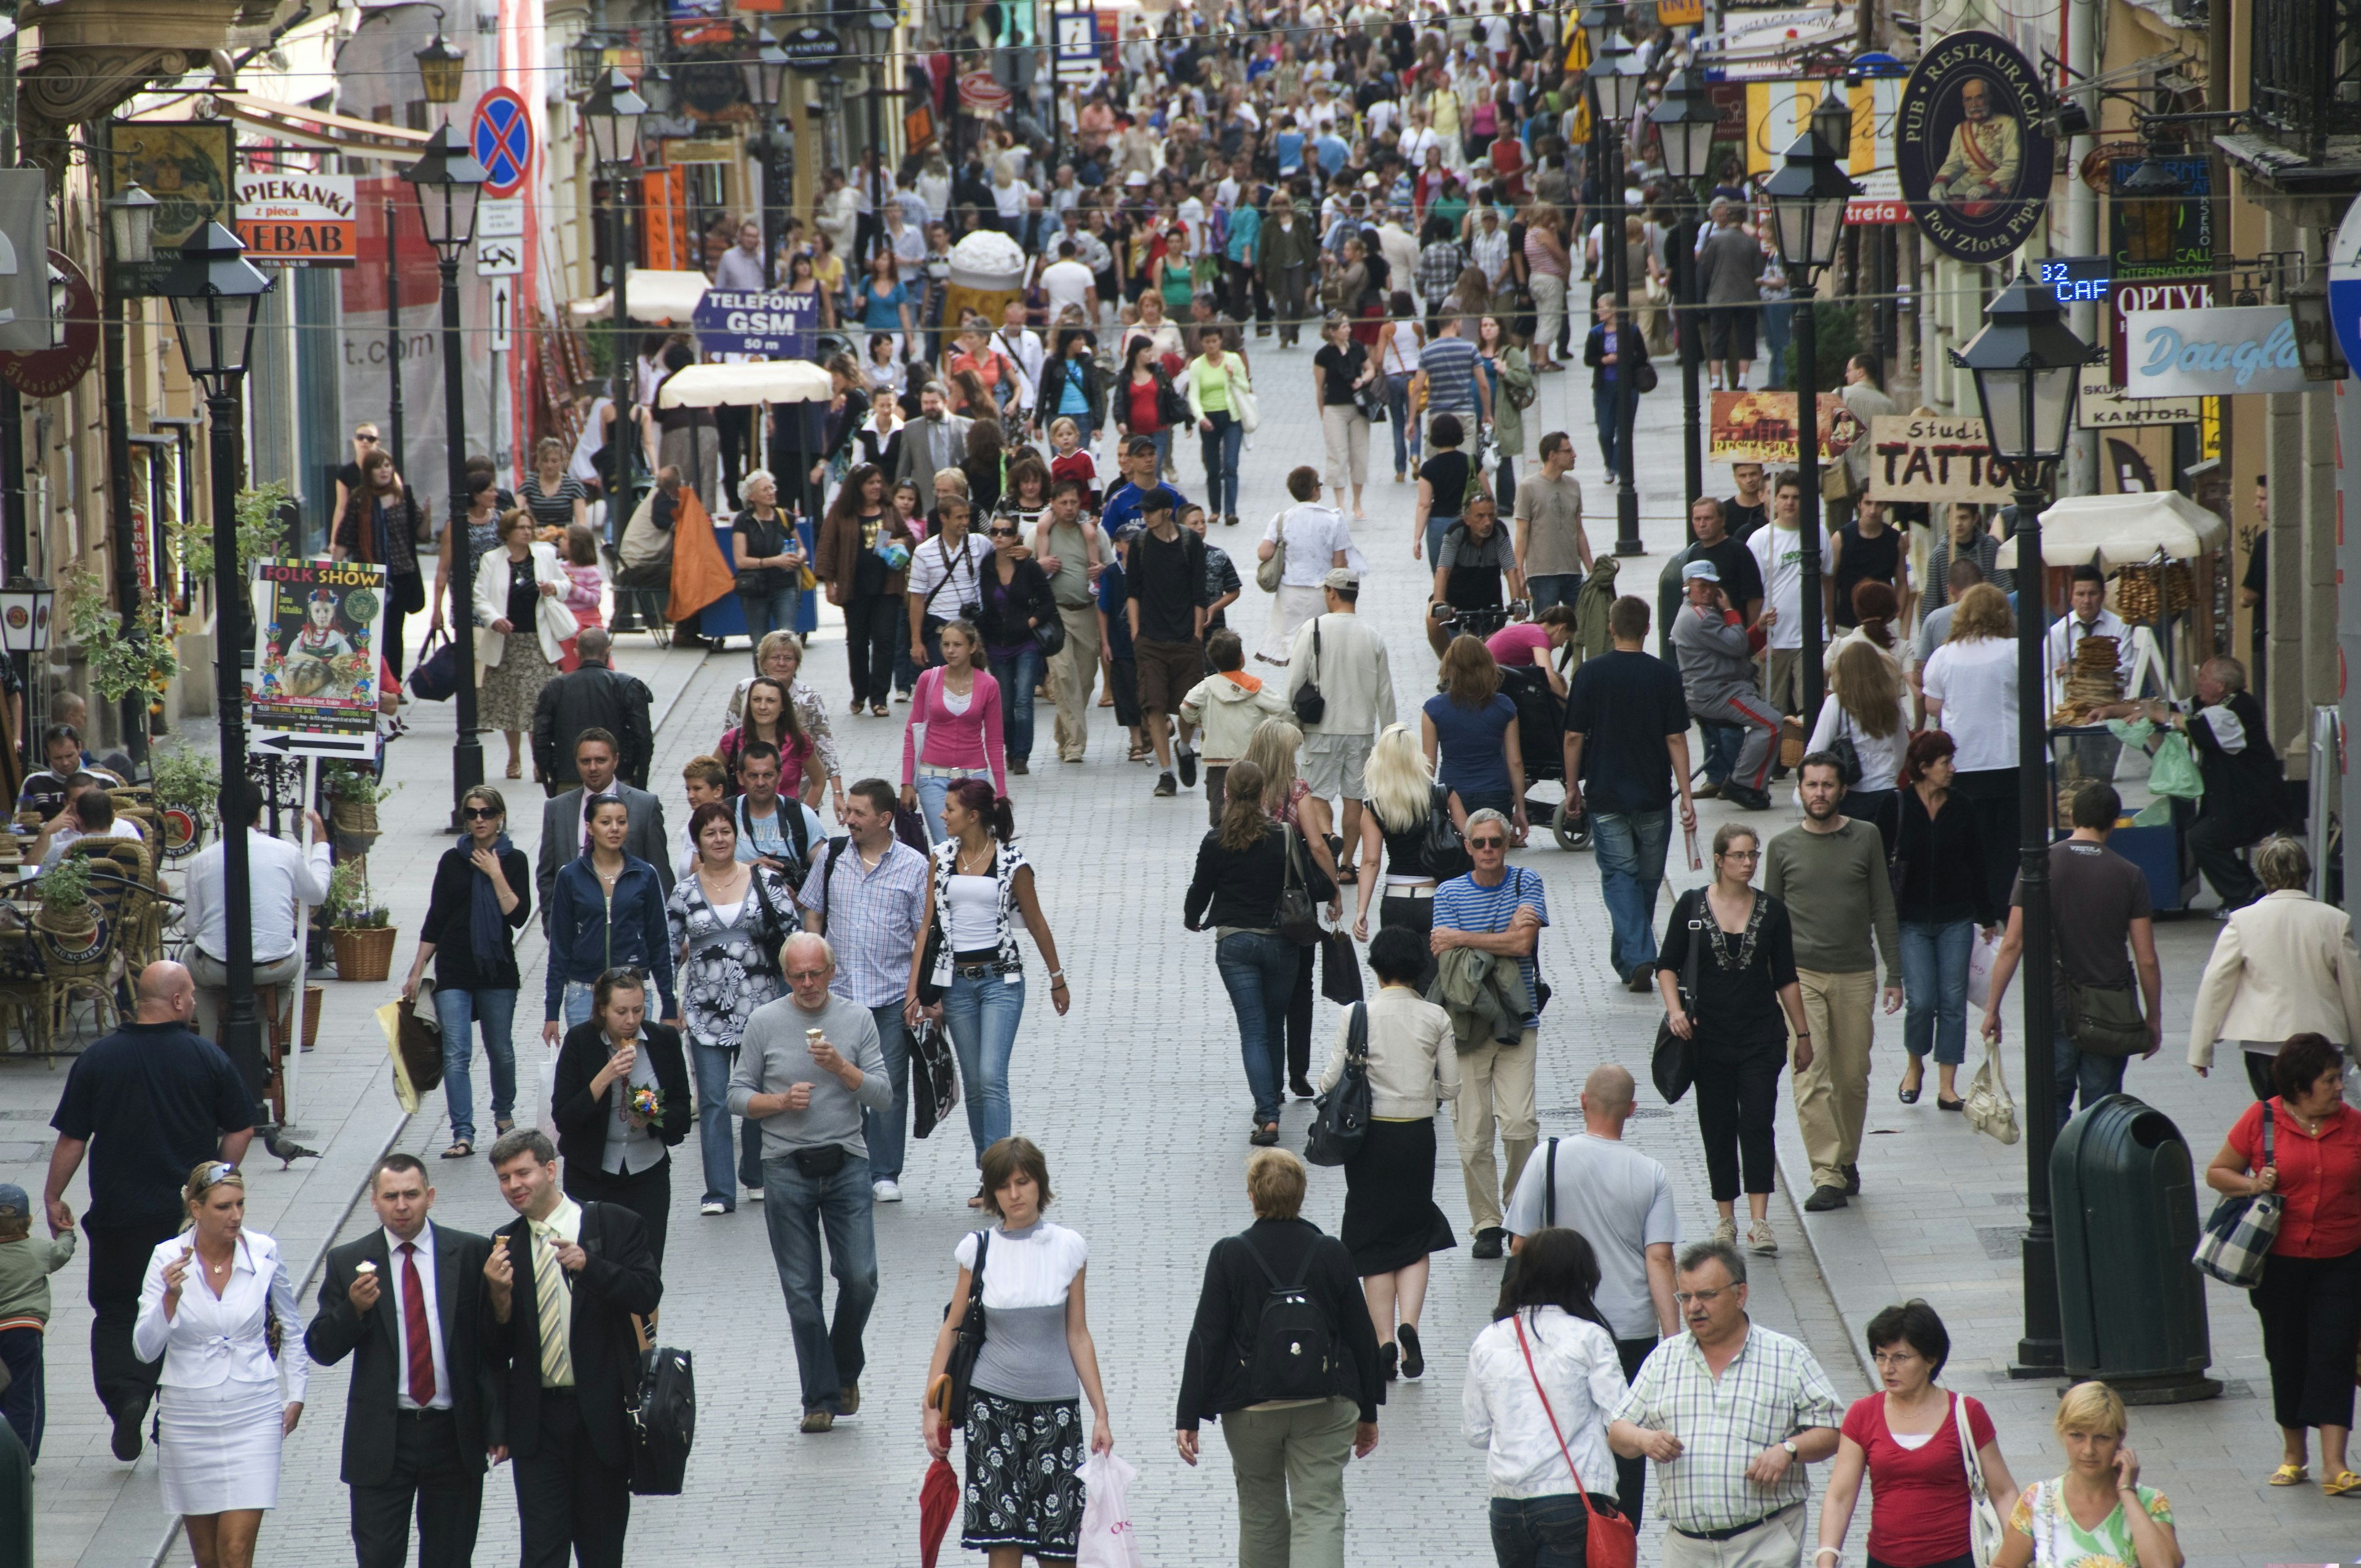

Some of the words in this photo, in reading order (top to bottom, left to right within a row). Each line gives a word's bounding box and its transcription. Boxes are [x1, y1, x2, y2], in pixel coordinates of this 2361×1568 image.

[1906, 100, 1926, 143] PUB
[1924, 44, 2042, 130] RESTAURACJA
[255, 207, 261, 216] z
[266, 205, 299, 218] pieca
[2199, 196, 2212, 246] KSERO
[1923, 208, 1956, 242] Pod
[1955, 232, 2013, 253] Złotą
[2006, 196, 2042, 234] Pipą
[708, 293, 813, 312] TELEFONY
[726, 311, 796, 336] GSM
[744, 338, 762, 349] 50
[765, 340, 779, 350] m
[5, 355, 86, 392] Floriańska
[2093, 408, 2190, 423] KANTOR
[1713, 440, 1831, 459] RESTAURAA
[133, 520, 146, 587] PROMOC
[265, 566, 314, 583] FOLK
[318, 569, 379, 587] SHOW
[52, 944, 100, 960] MÜNCHEN
